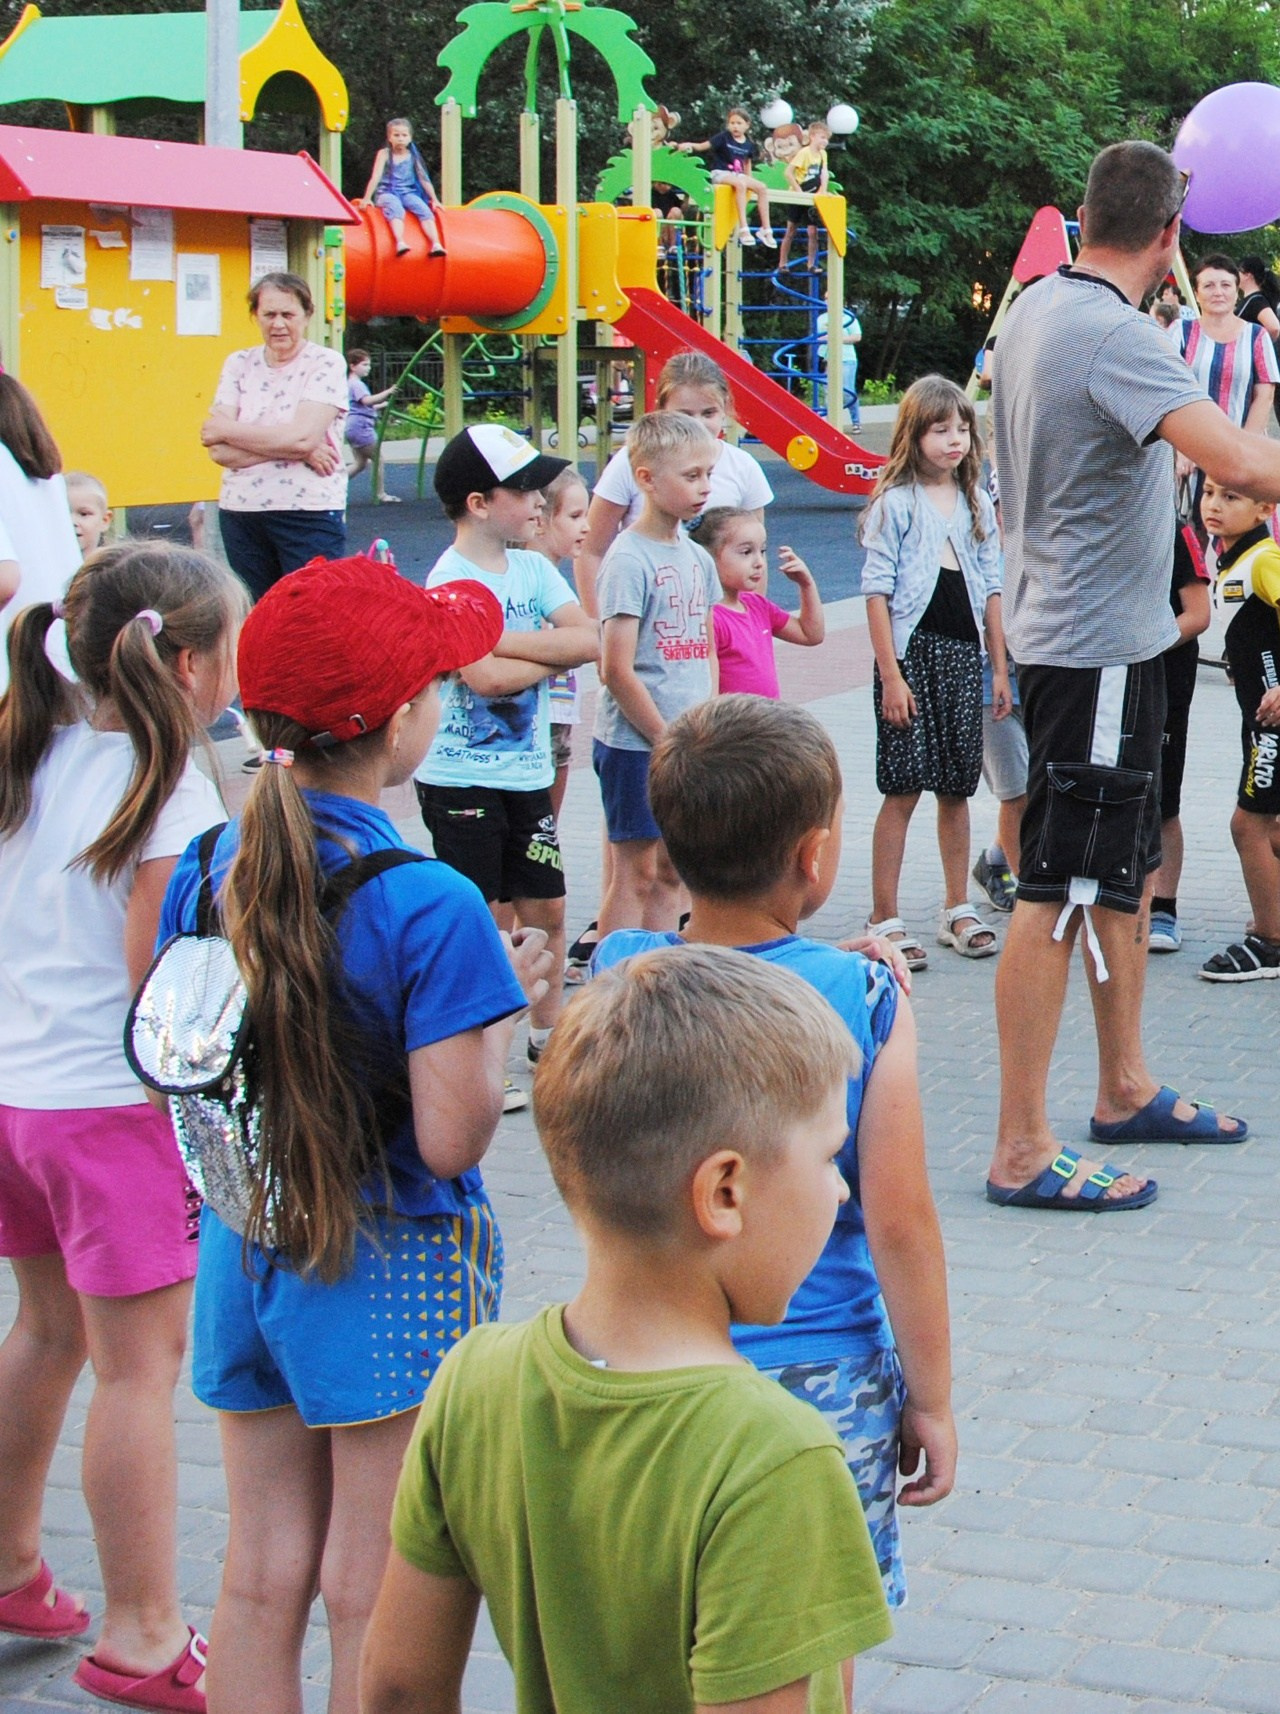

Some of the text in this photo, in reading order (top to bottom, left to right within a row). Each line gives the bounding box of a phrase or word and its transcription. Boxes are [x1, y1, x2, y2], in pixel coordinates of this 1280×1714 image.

[653, 564, 708, 640] 34
[1260, 650, 1280, 688] LEGENDAR
[525, 840, 564, 872] SPO
